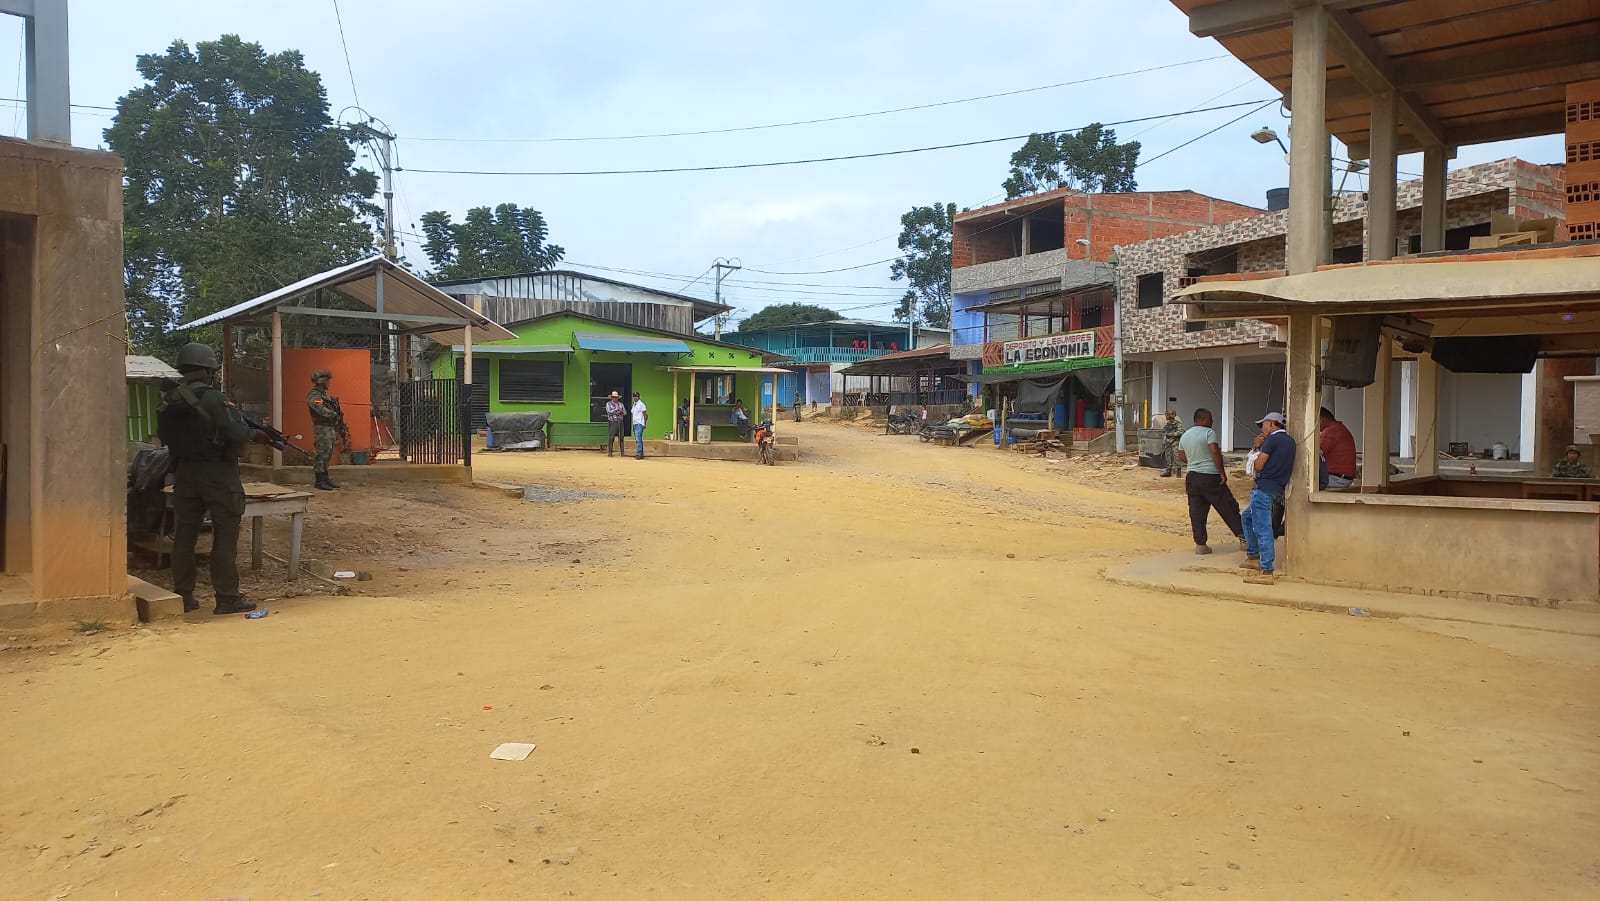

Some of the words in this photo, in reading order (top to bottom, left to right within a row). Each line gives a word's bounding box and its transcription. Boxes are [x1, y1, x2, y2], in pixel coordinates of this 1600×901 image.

[1047, 334, 1092, 346] LEGUMBRES
[1006, 350, 1021, 363] LA
[1025, 342, 1090, 361] ECONOMIA
